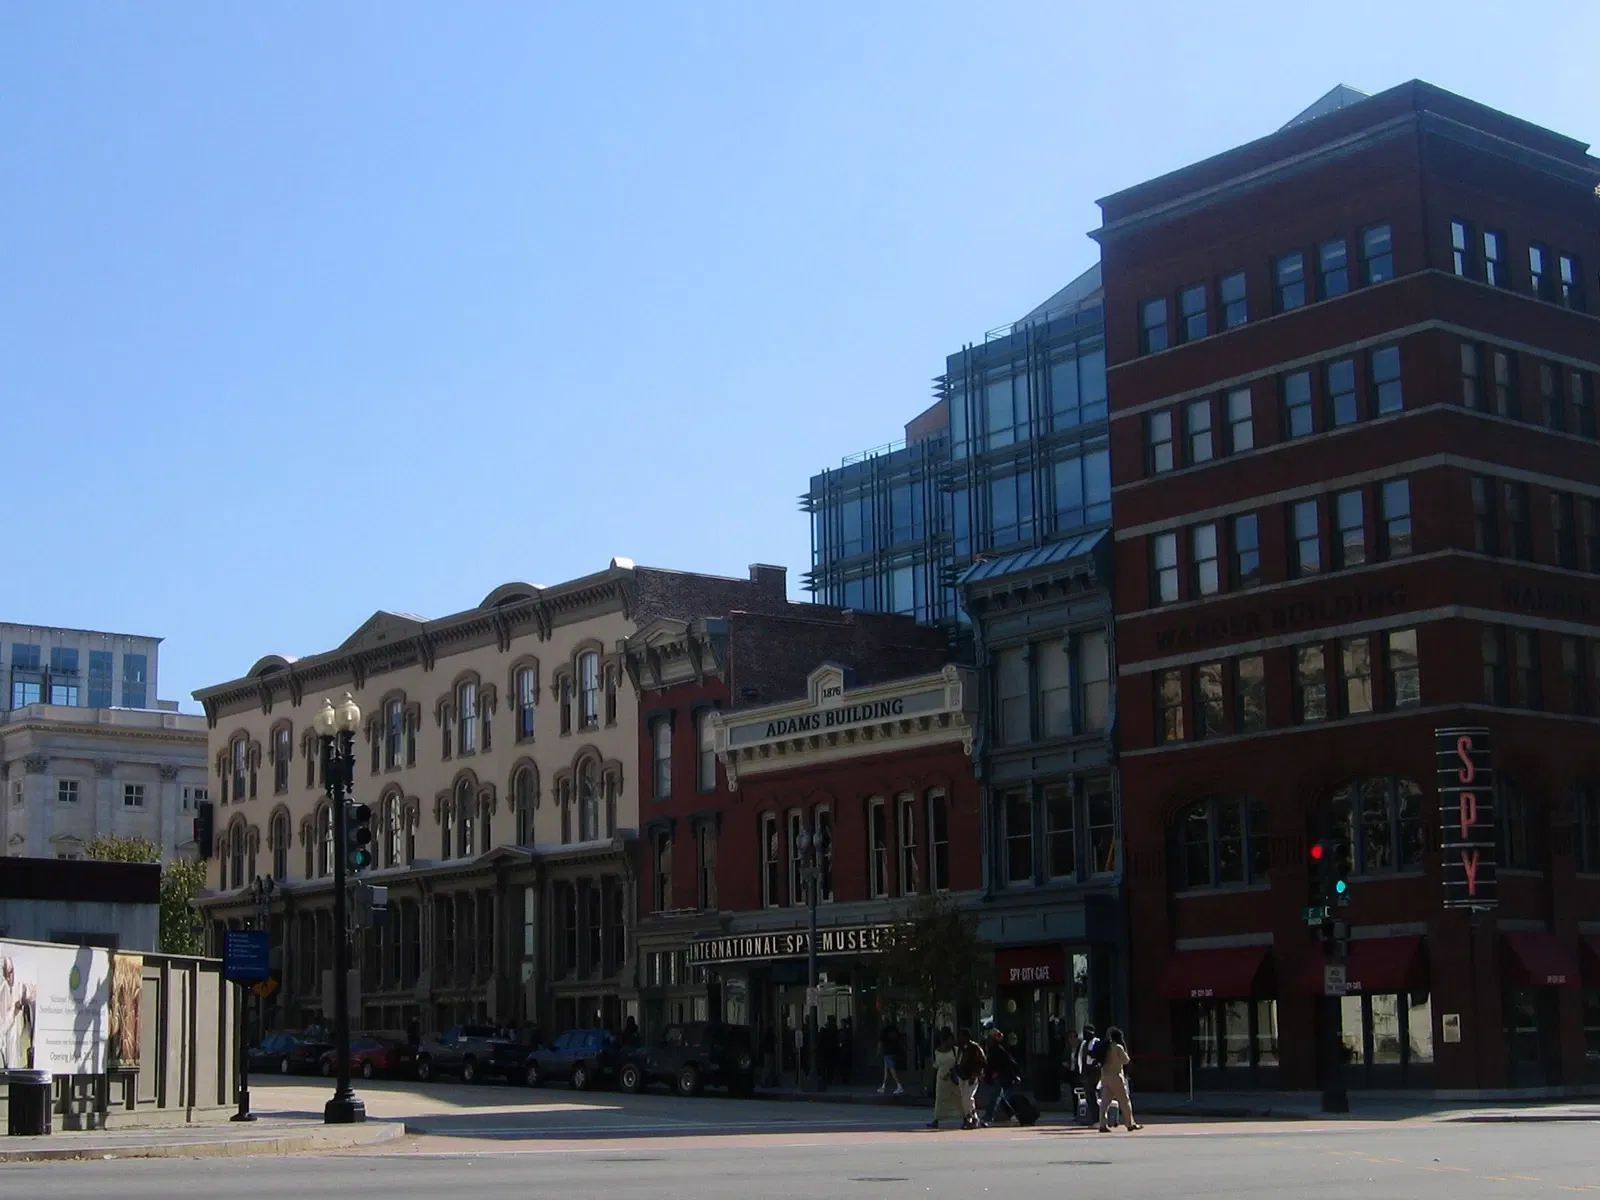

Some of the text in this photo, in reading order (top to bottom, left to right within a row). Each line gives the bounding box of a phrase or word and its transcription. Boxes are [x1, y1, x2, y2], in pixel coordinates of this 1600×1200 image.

[1271, 585, 1408, 629] BUILDING
[823, 686, 841, 698] 1876
[766, 699, 904, 737] ADAMS BUILDING
[1456, 735, 1480, 896] SPY
[688, 936, 779, 961] INTERNATIONAL
